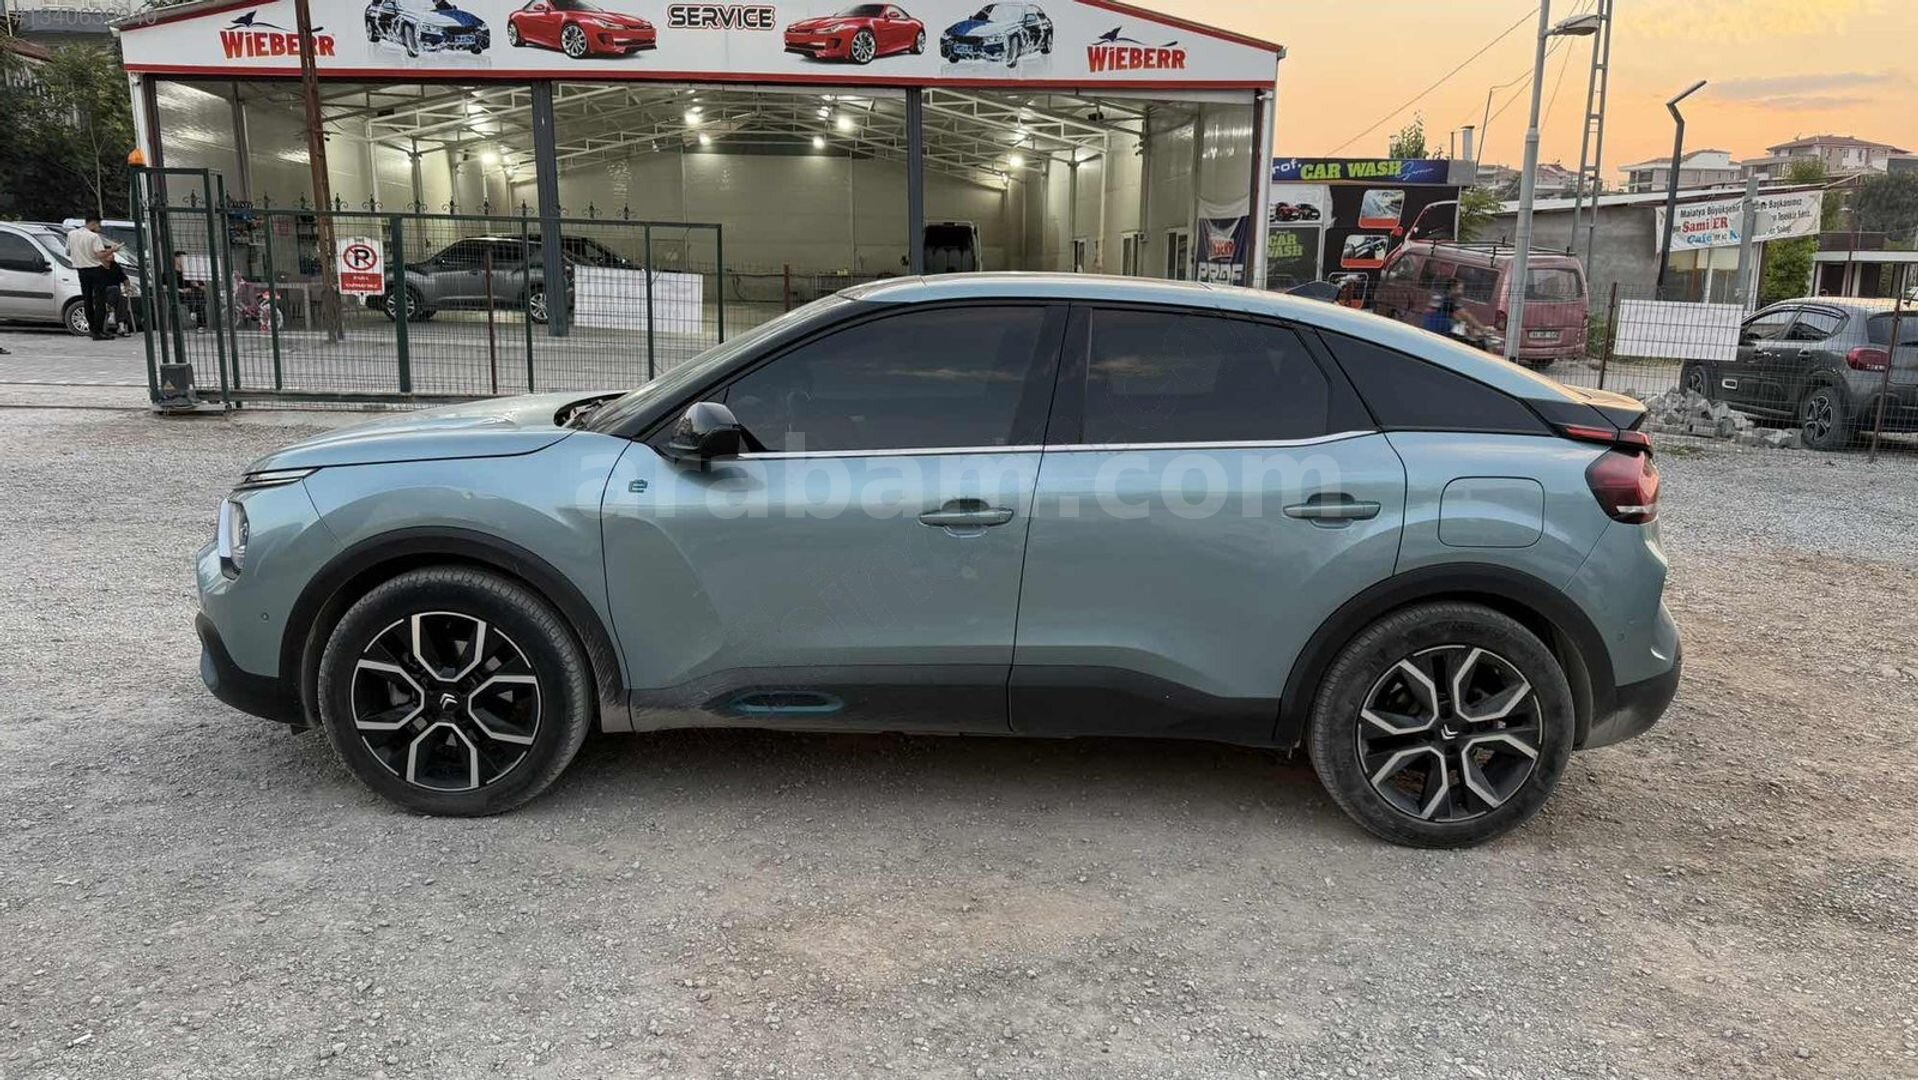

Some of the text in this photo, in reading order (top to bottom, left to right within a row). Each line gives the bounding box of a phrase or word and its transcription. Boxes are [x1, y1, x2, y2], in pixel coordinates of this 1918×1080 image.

[669, 5, 773, 28] SERVICE
[1300, 162, 1341, 180] CAR
[1348, 161, 1402, 177] WASH
[1681, 207, 1706, 218] Malatya
[1682, 219, 1710, 233] Sami
[1711, 216, 1729, 230] ER
[1268, 234, 1298, 247] CAR
